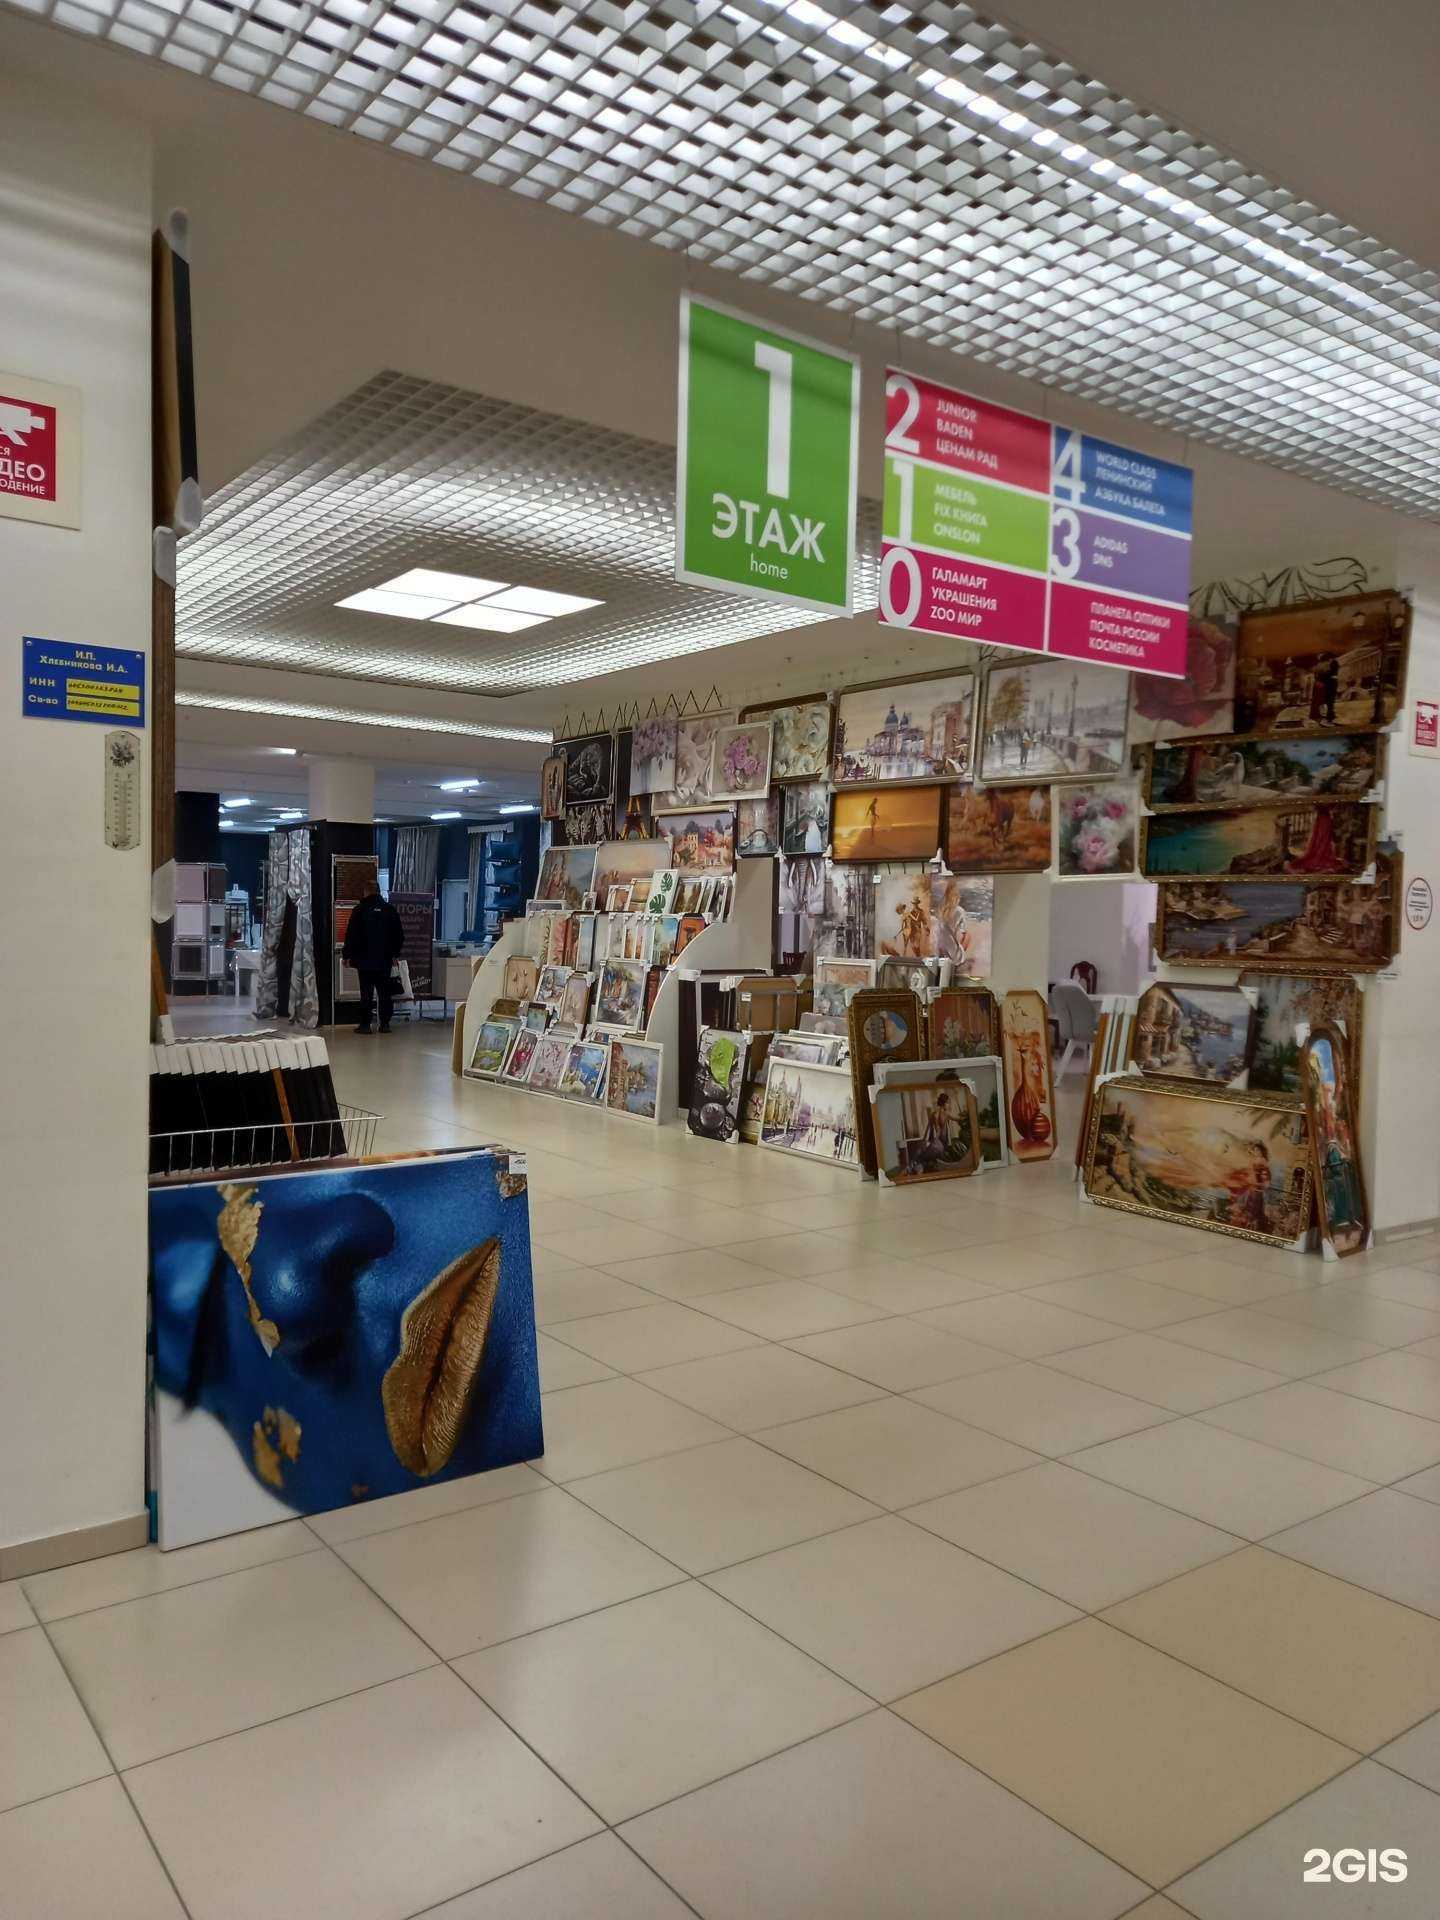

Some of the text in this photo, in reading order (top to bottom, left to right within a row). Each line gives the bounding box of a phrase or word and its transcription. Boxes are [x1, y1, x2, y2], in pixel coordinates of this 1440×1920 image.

[754, 340, 793, 500] 1
[885, 374, 920, 454] 2
[936, 399, 977, 423] JUNIOR
[936, 418, 973, 440] BADEN
[936, 438, 998, 471] ЦЕНАМ РАД
[1095, 449, 1158, 480] WORLD CLASS
[1051, 431, 1087, 505] 4
[893, 459, 914, 546] 1
[711, 492, 826, 563] ЭТАЖ
[1051, 507, 1081, 580] 3
[1093, 535, 1128, 554] ADIDAS
[750, 552, 789, 579] home
[1092, 552, 1114, 568] DNS
[880, 546, 922, 628] 0
[931, 567, 988, 590] ГАЛАМАРТ
[930, 586, 997, 611] УКРАШЕНИЯ
[930, 605, 982, 627] ZOO МИР
[1090, 601, 1171, 629] ПЛАНЕТА ОПТИКИ
[1089, 619, 1160, 643] ПОЧТА РОССИИ
[75, 649, 97, 661] И.П.
[1088, 637, 1145, 658] КОСМЕТИКА
[106, 662, 129, 674] И.А.
[29, 676, 56, 687] ИНН
